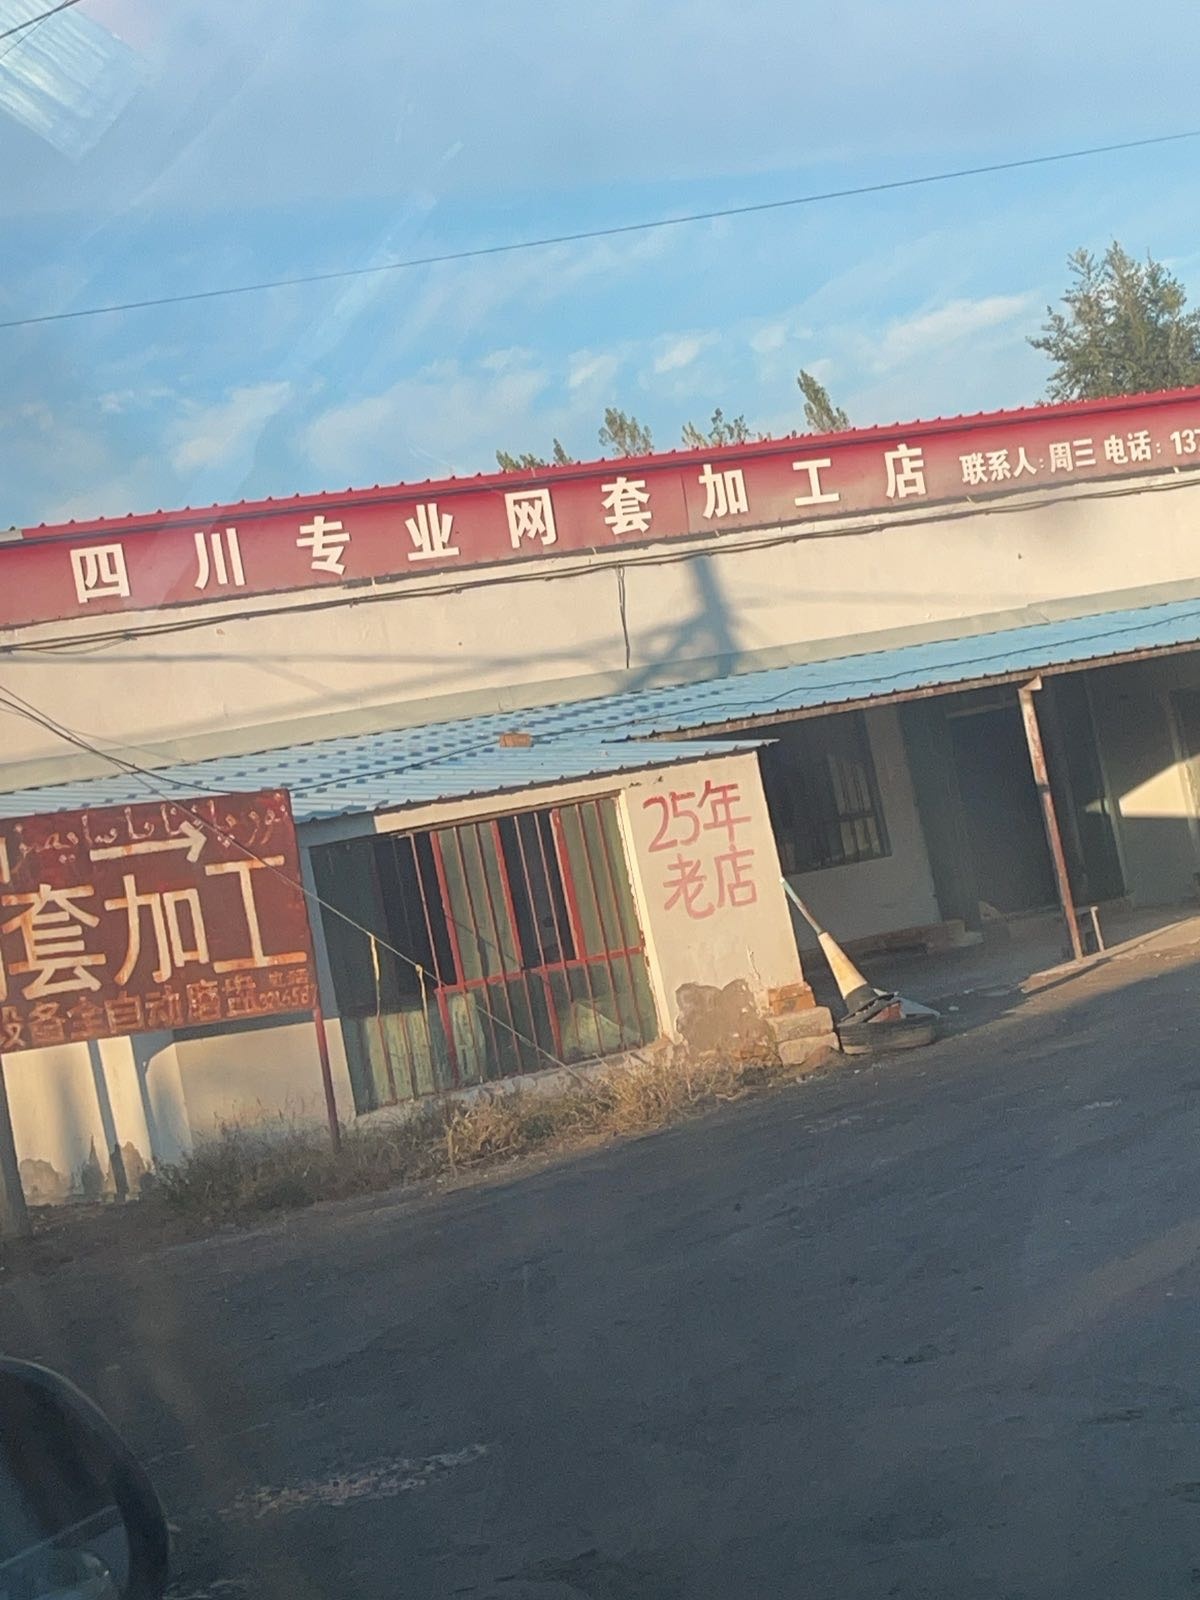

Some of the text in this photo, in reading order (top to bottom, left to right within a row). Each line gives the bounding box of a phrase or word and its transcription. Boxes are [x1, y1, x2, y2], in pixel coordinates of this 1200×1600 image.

[70, 443, 927, 604] 四川专业网套加工店
[643, 780, 752, 852] 25年
[0, 837, 307, 1001] 套加工
[663, 844, 758, 920] 老店
